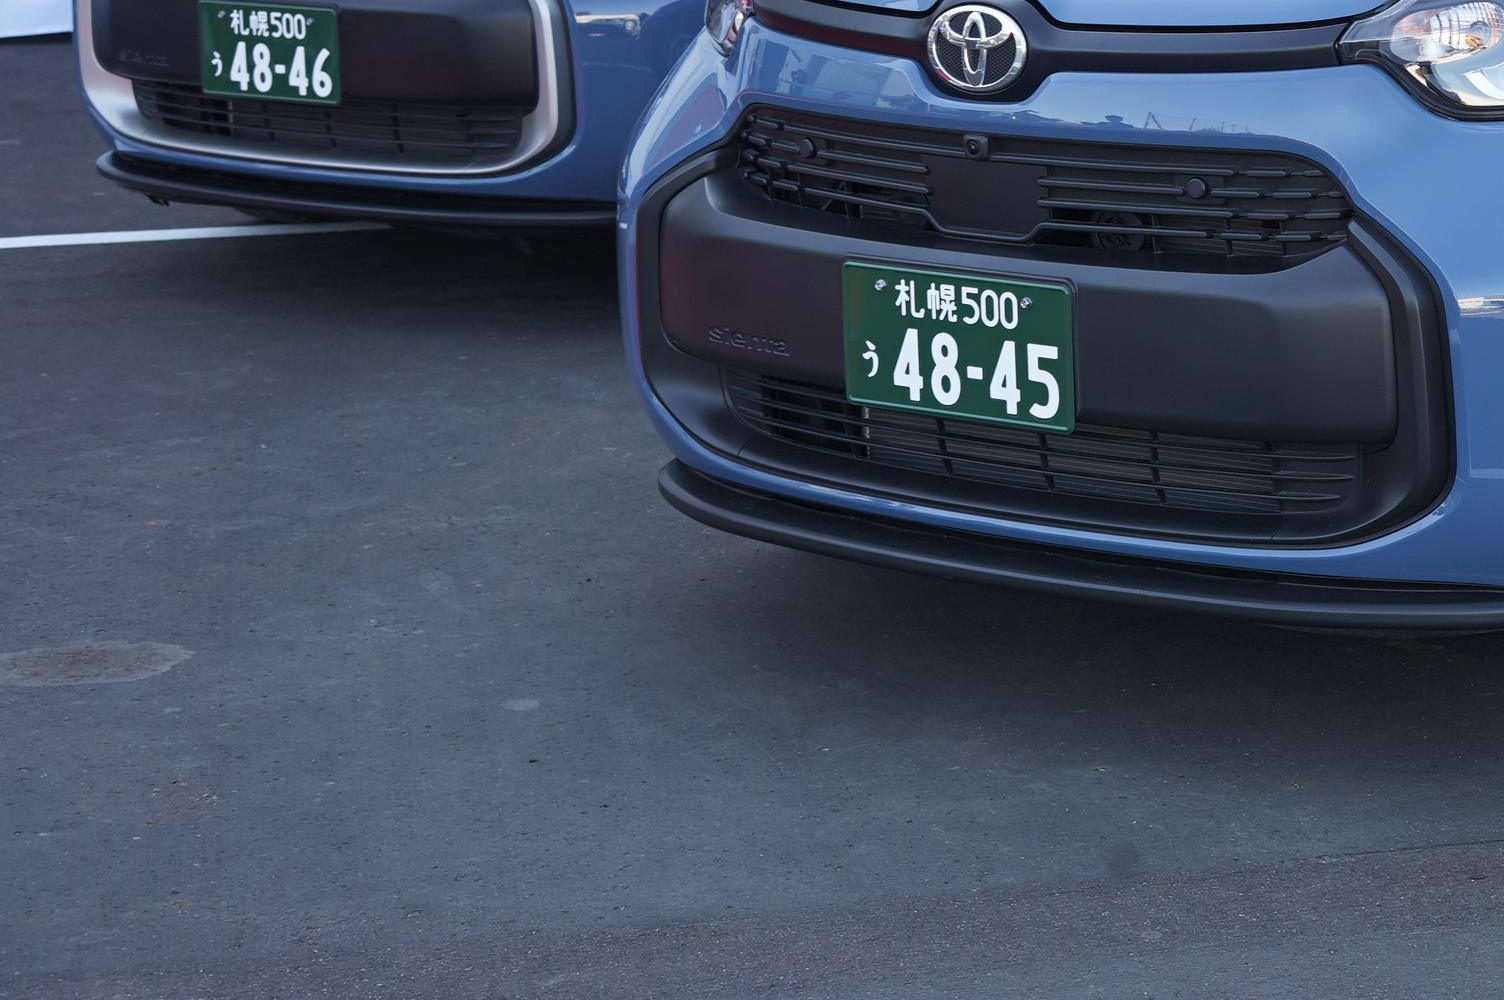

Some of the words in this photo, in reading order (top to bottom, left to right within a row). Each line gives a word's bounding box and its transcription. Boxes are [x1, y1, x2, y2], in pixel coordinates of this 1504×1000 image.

[229, 9, 307, 40] 札幌500
[211, 50, 223, 77] う
[229, 41, 333, 98] 48-46
[894, 279, 1019, 330] 札幌500
[862, 340, 880, 378] う
[893, 327, 1061, 420] 48-45
